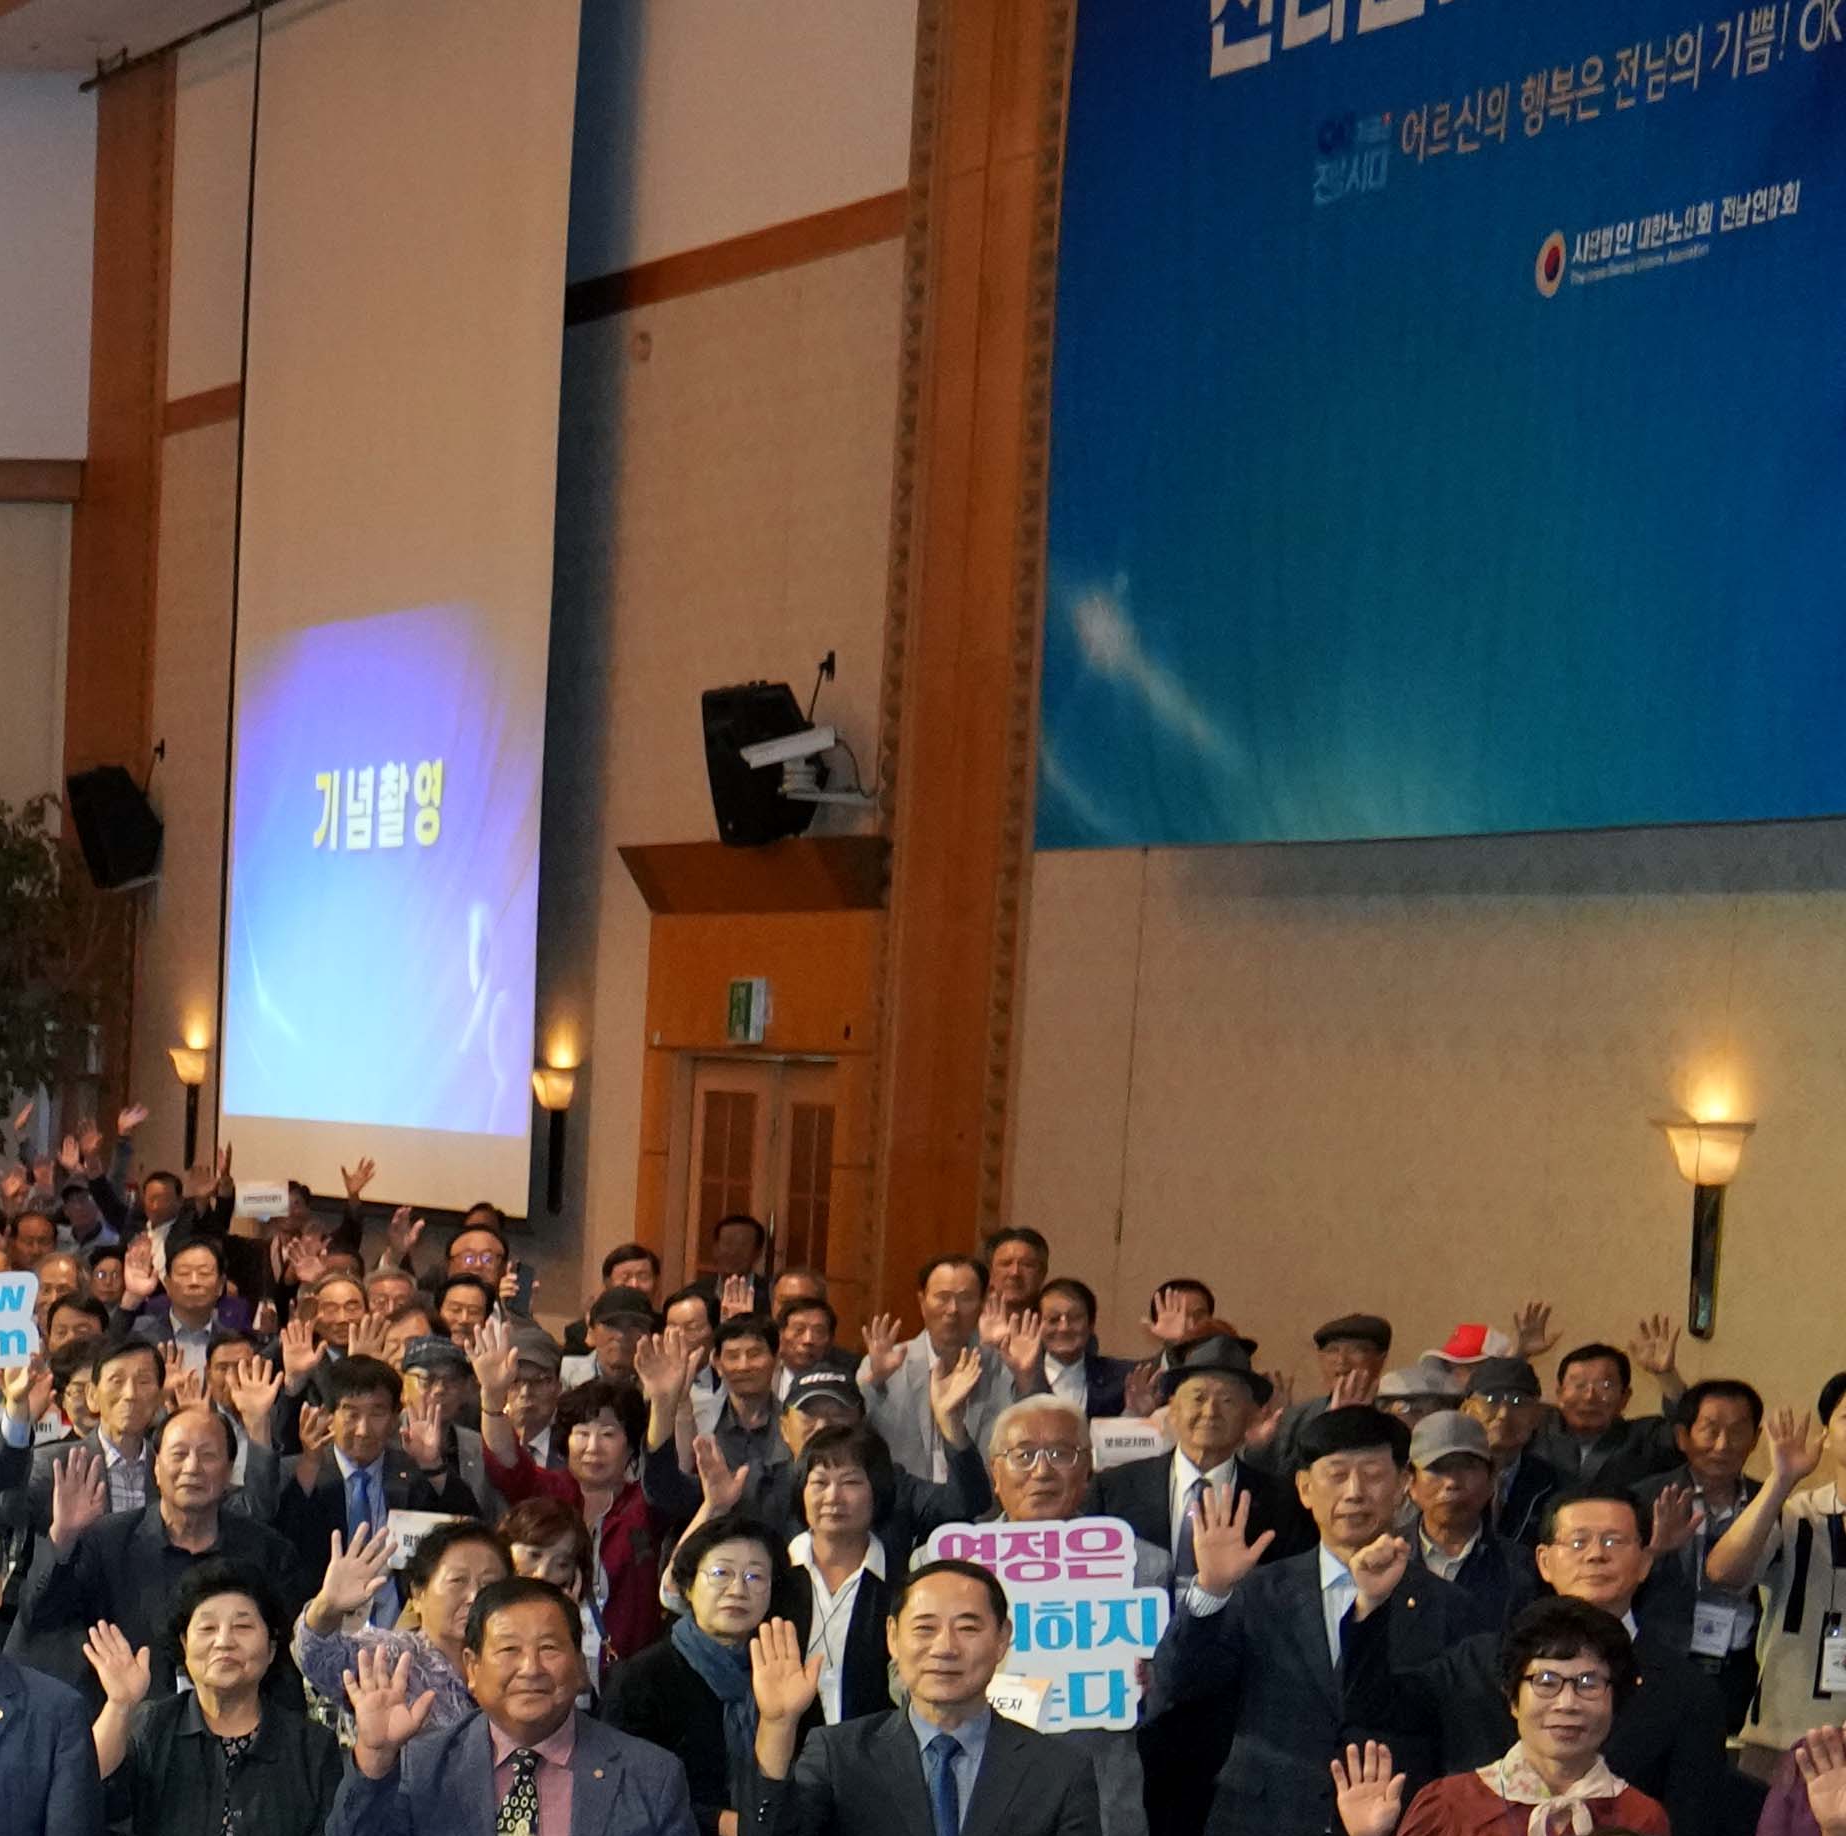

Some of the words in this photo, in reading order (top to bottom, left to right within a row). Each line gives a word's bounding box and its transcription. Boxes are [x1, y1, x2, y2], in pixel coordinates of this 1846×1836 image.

[1400, 81, 1510, 165] 어르신의
[1521, 56, 1605, 137] 행복은
[1615, 23, 1704, 110] 전남의
[1711, 3, 1790, 80] 기쁨!
[312, 758, 445, 851] 기념촬영
